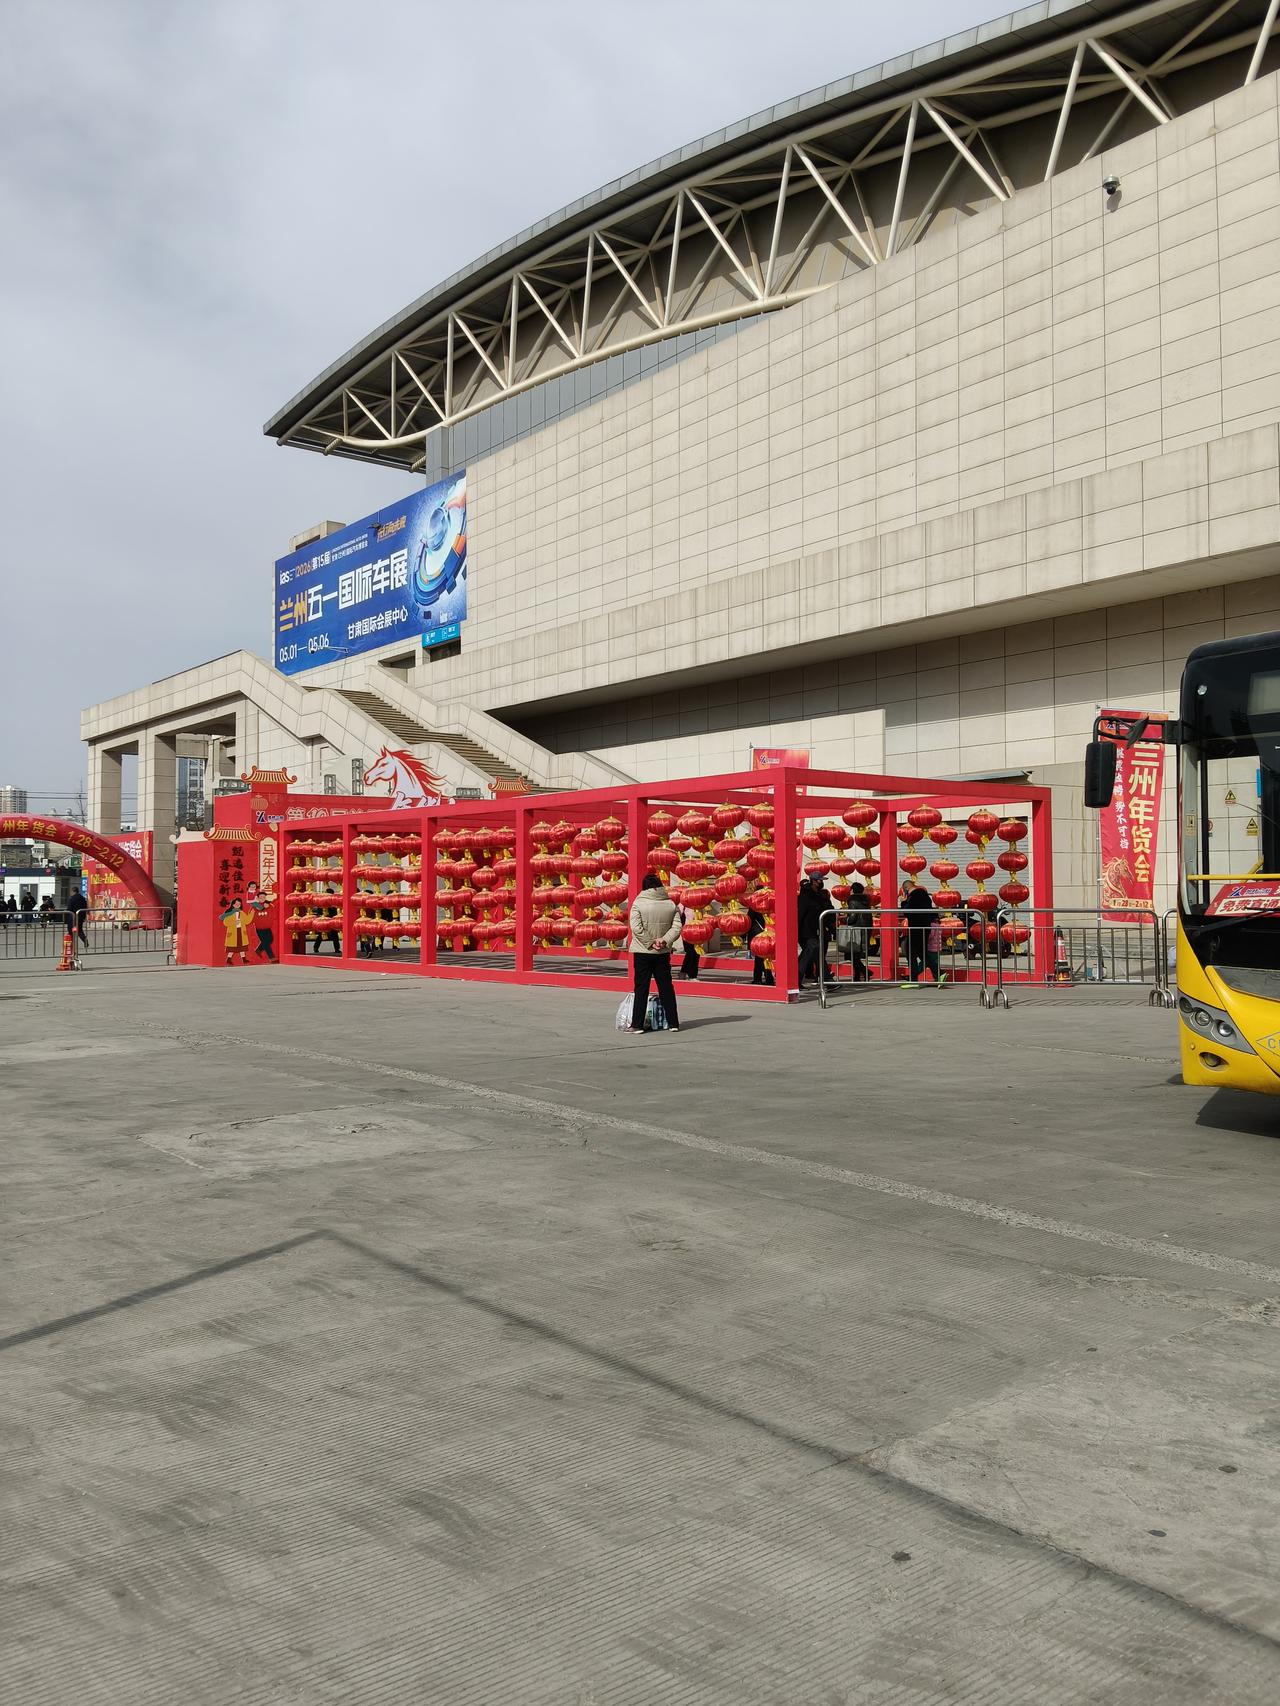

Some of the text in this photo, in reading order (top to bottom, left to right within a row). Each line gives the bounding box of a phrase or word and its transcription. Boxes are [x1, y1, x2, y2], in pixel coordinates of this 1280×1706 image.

[347, 605, 409, 640] 甘肃国际会展中心
[0, 820, 57, 837] 州年货会
[1128, 741, 1160, 883] 兰州年货会
[219, 858, 231, 907] 喜迎新春
